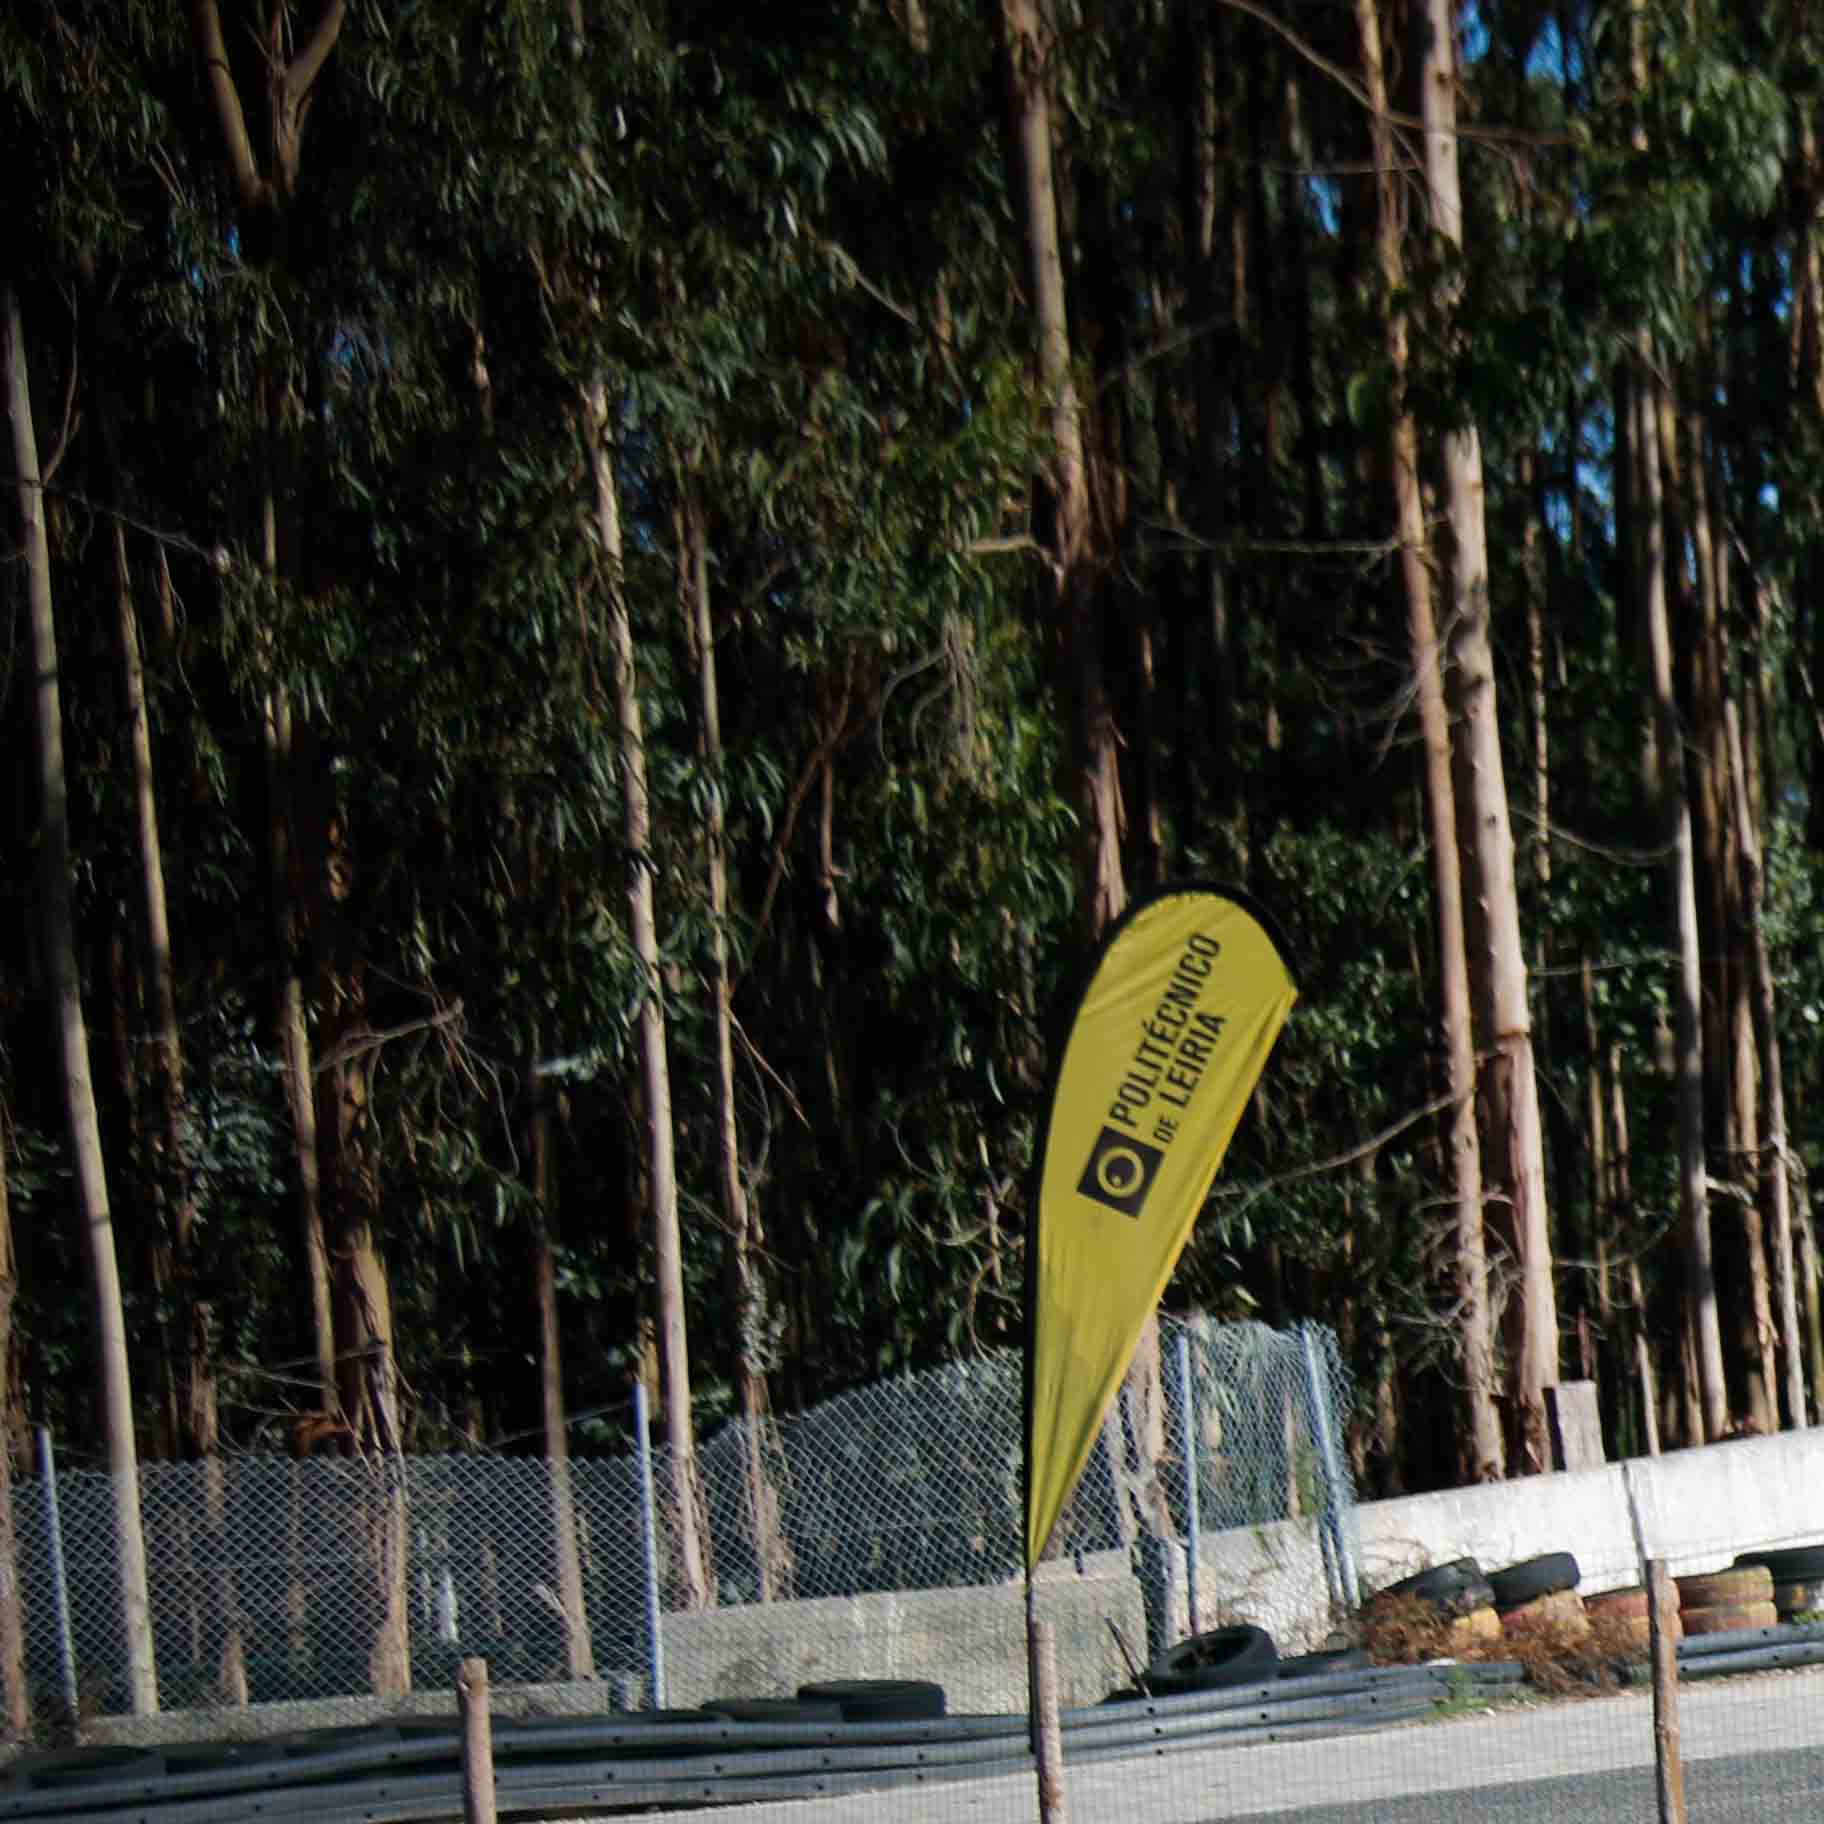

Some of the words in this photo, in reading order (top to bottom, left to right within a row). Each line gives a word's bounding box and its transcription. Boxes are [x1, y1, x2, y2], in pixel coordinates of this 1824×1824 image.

[1109, 932, 1221, 1128] POLITÉCNICO
[1158, 1011, 1227, 1108] LEIRIA
[1152, 1113, 1179, 1145] DE
